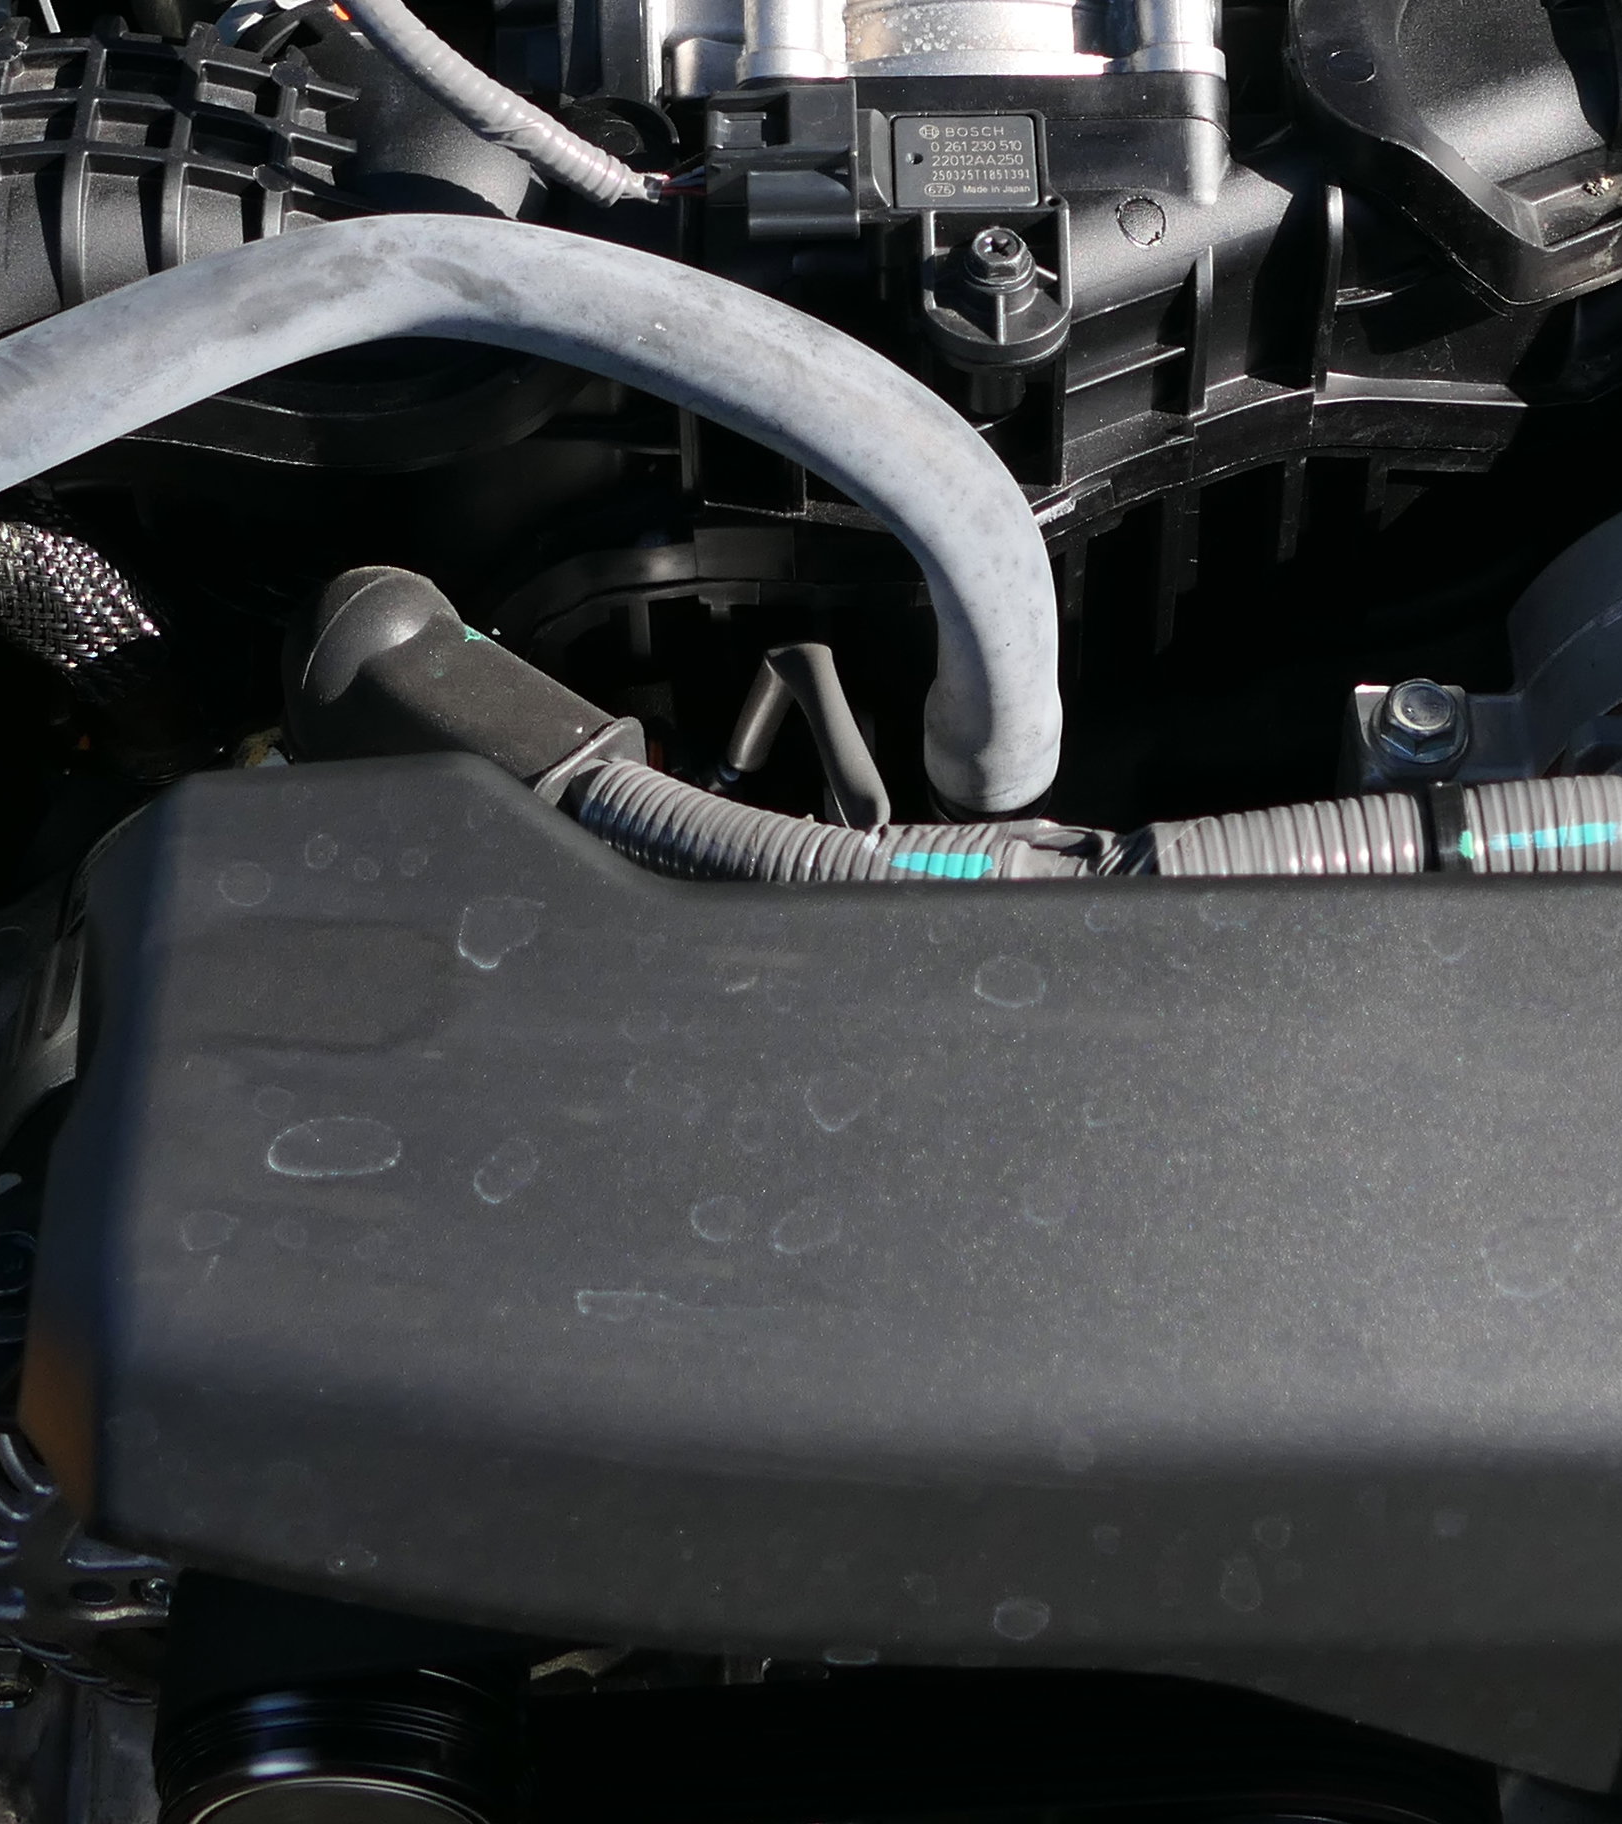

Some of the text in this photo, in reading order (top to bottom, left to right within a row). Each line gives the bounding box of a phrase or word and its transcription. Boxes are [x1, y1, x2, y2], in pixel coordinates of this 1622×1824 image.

[945, 126, 1004, 137] BOSCH
[931, 140, 1022, 152] 0 261 230 510
[931, 154, 1024, 167] 22012AA250
[929, 185, 1031, 195] 676 Made in Japan
